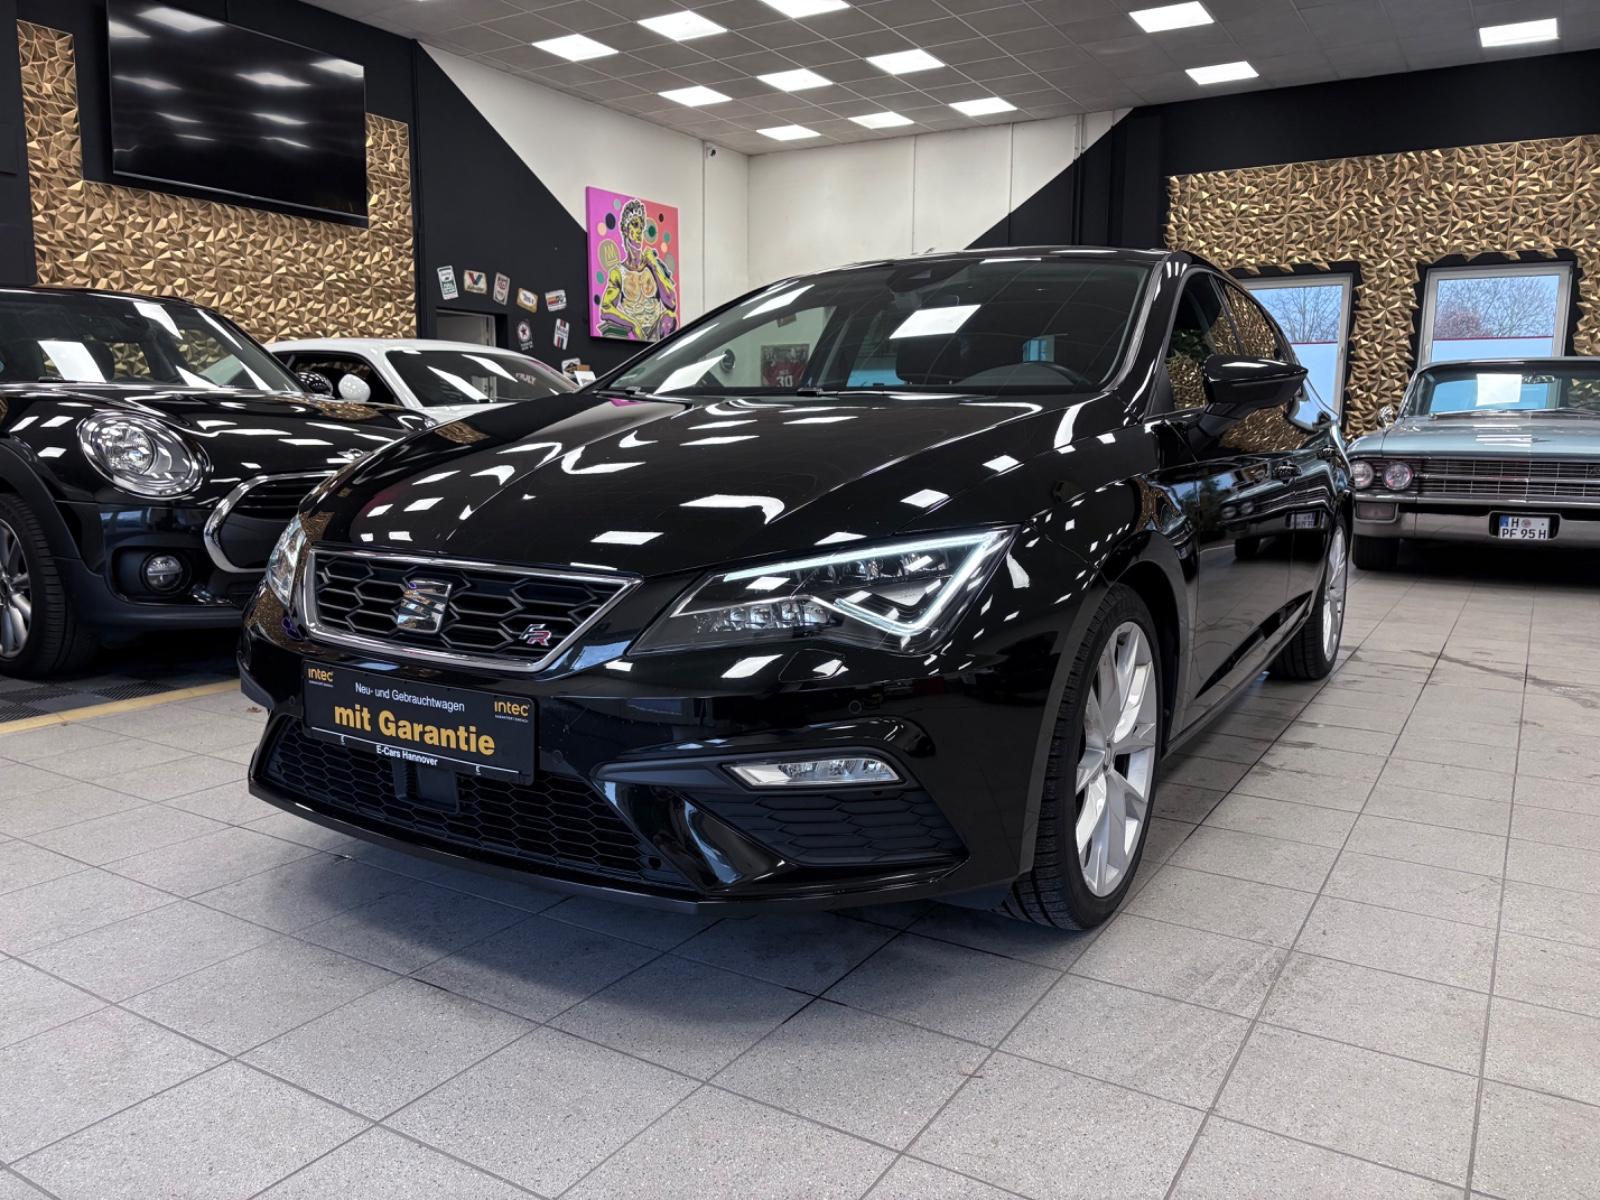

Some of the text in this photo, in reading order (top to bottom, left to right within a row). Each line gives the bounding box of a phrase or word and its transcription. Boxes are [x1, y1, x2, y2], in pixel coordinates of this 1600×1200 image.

[1511, 517, 1519, 528] H
[1502, 528, 1518, 538] PF
[1520, 528, 1536, 539] 95
[518, 623, 552, 646] FR
[307, 667, 334, 682] intec
[354, 682, 466, 713] Neu- und Gebrauchtwagen
[494, 700, 529, 717] intec
[334, 703, 495, 756] mit Garantie
[376, 744, 438, 766] E-Cars Hannover
